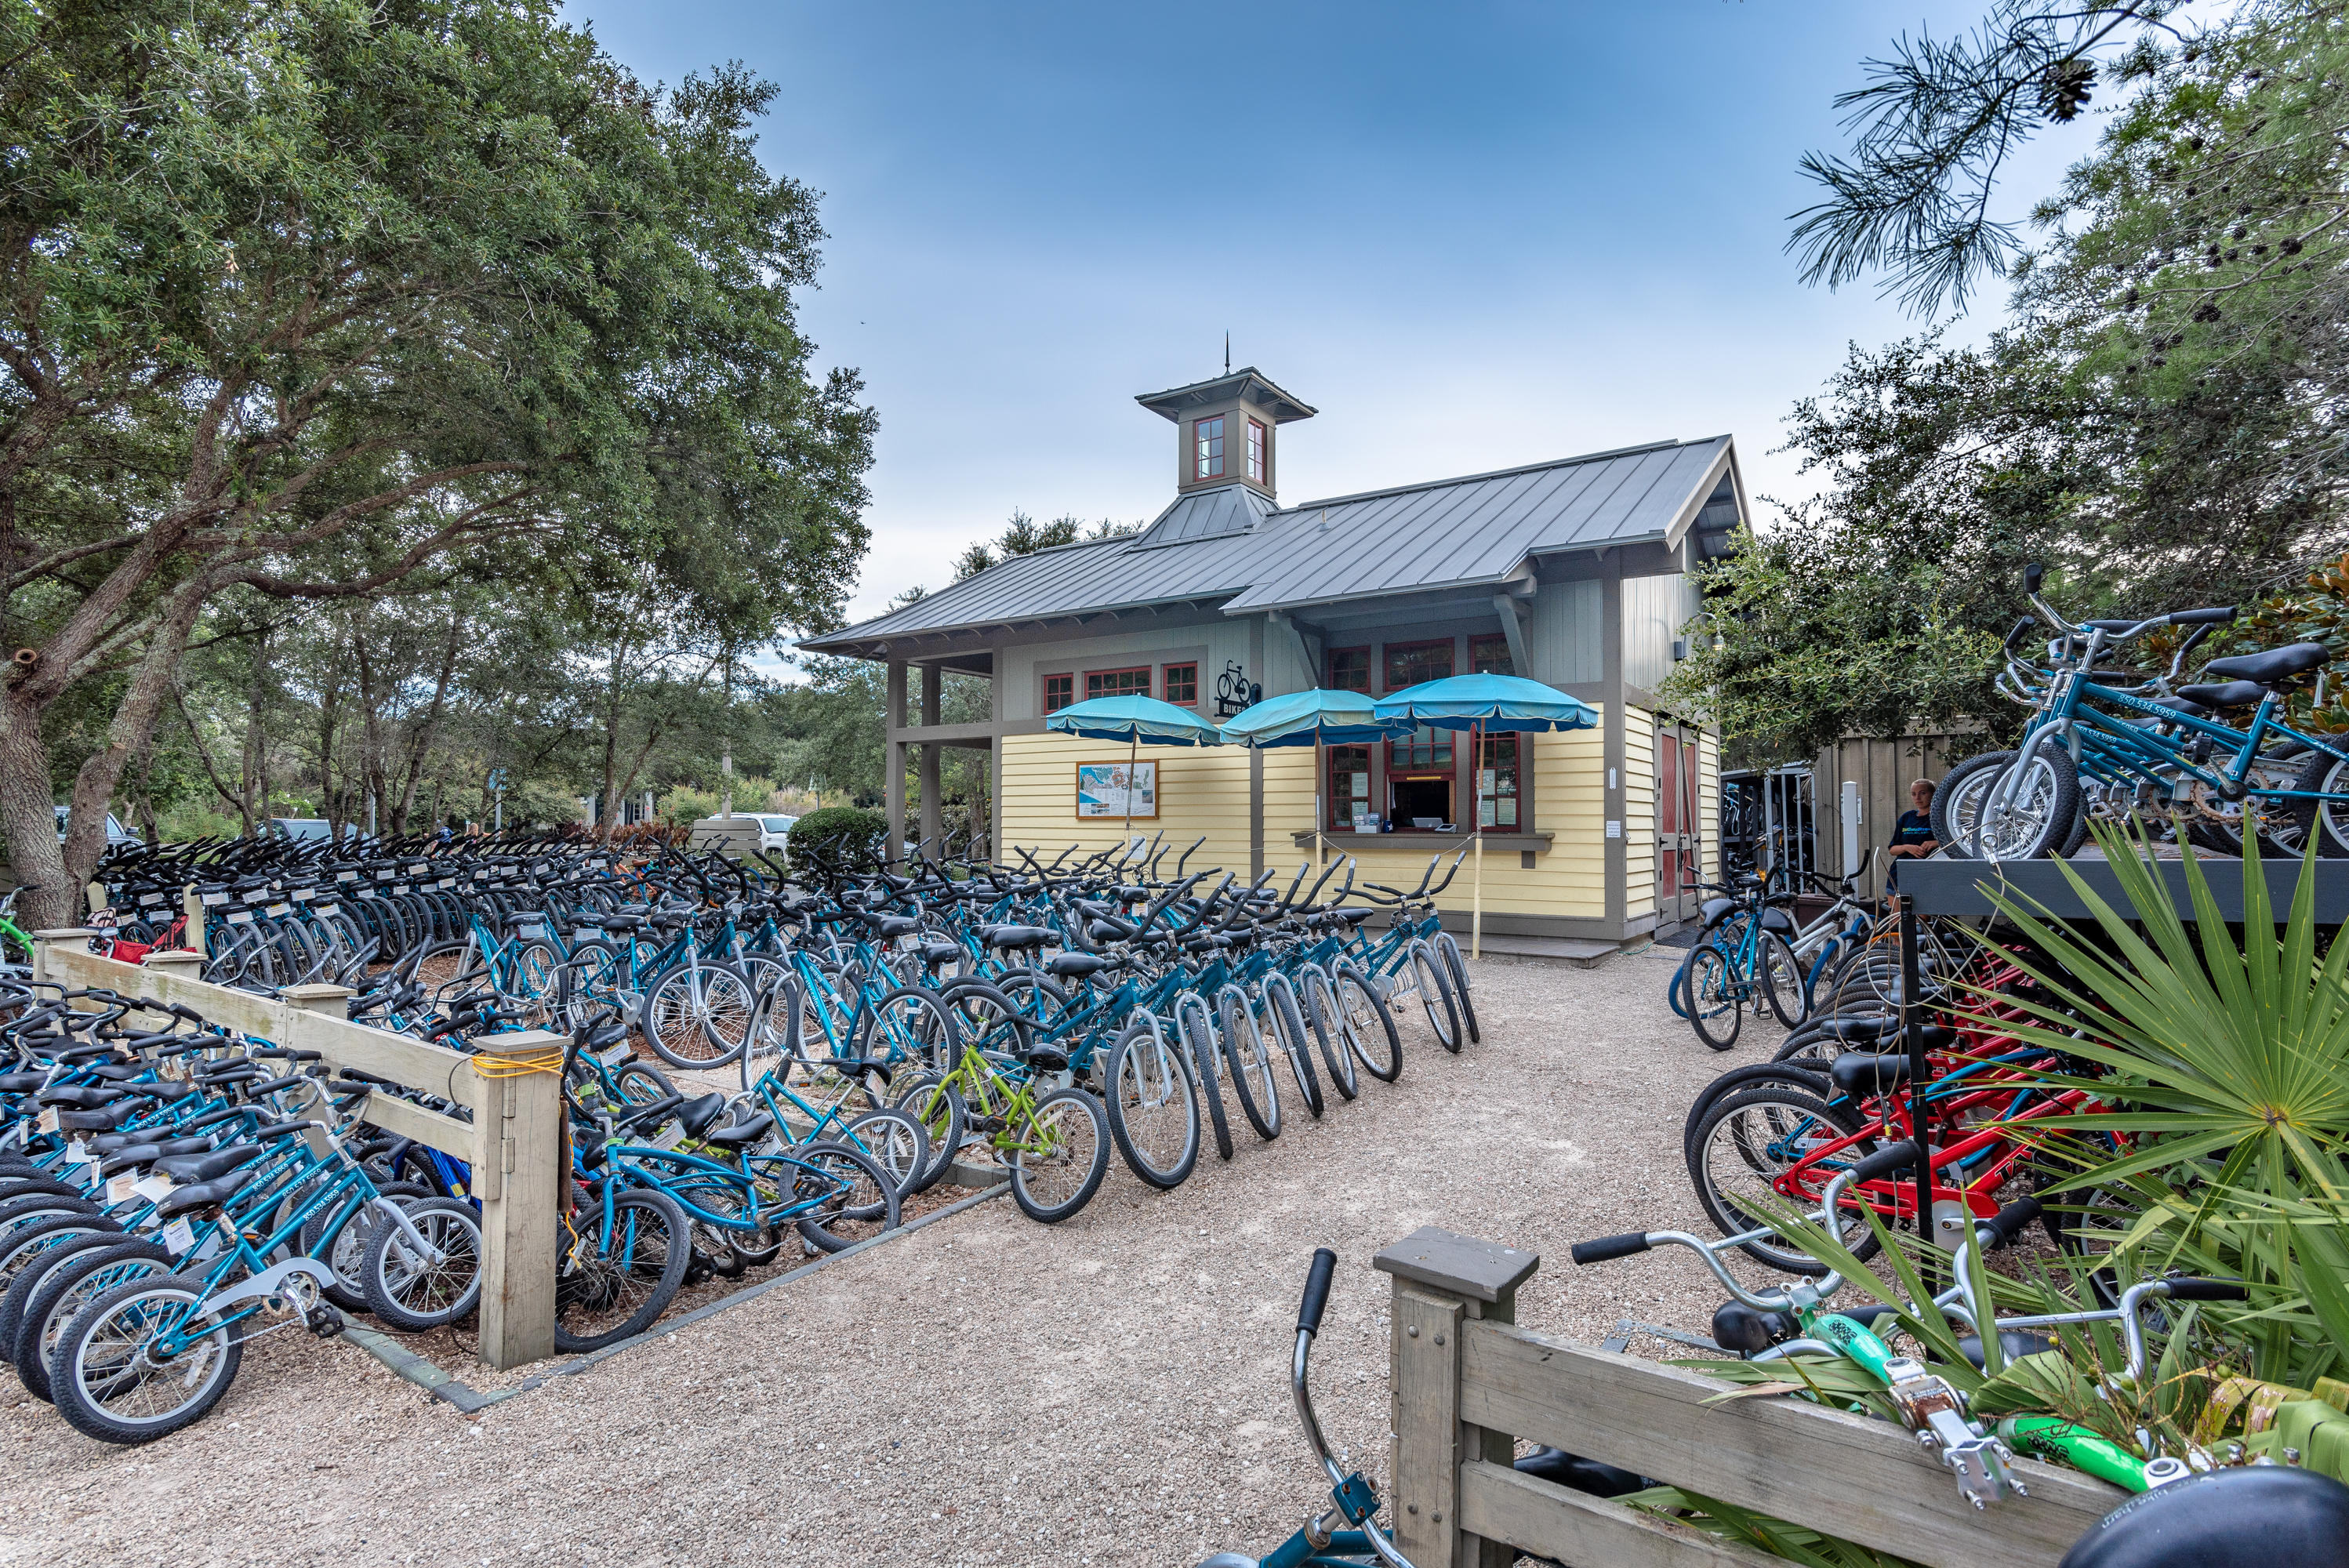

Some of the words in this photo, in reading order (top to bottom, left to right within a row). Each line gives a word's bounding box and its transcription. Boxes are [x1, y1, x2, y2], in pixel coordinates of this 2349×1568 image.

[1223, 702, 1247, 715] BIKES
[2118, 694, 2177, 719] 850.534.5959
[303, 1189, 340, 1221] 850.534.5959
